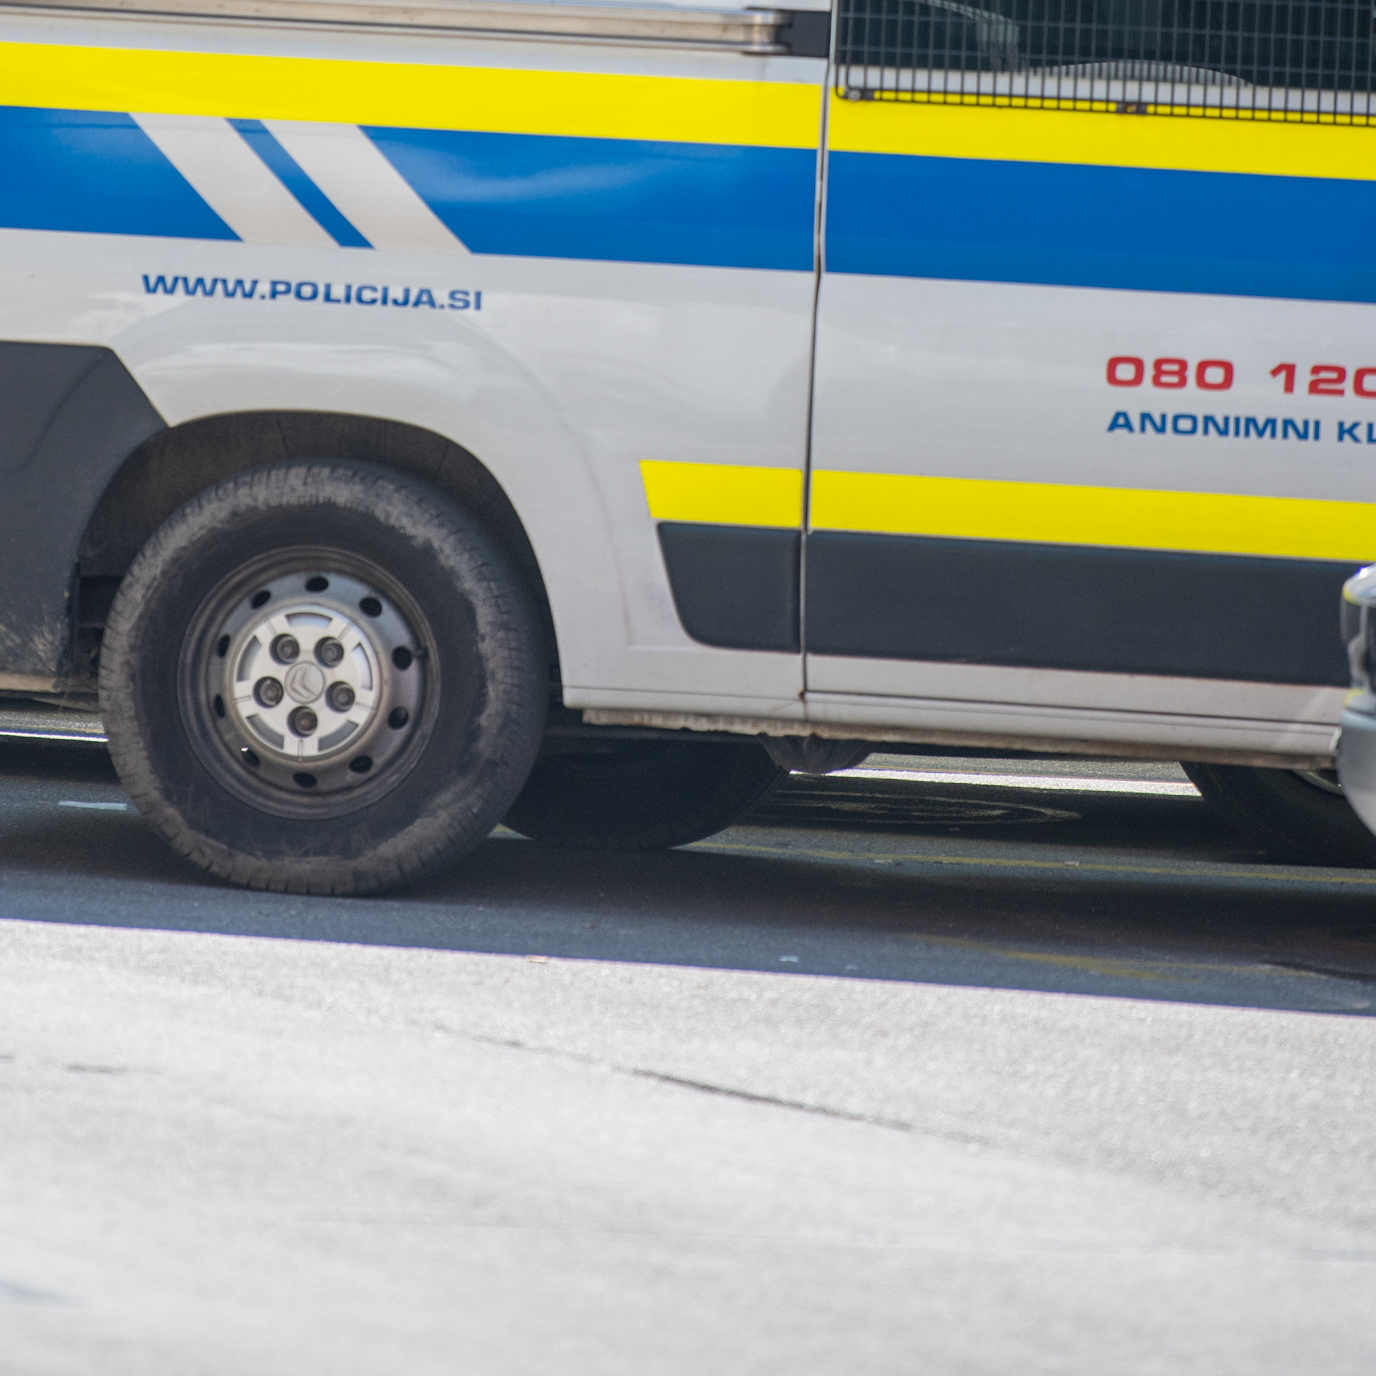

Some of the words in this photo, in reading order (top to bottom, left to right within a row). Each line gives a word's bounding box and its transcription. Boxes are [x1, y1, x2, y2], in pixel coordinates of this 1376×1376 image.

[141, 273, 482, 311] WWW.POLICIJA.SI
[1105, 355, 1234, 391] 080
[1106, 410, 1321, 442] ANONIMNI
